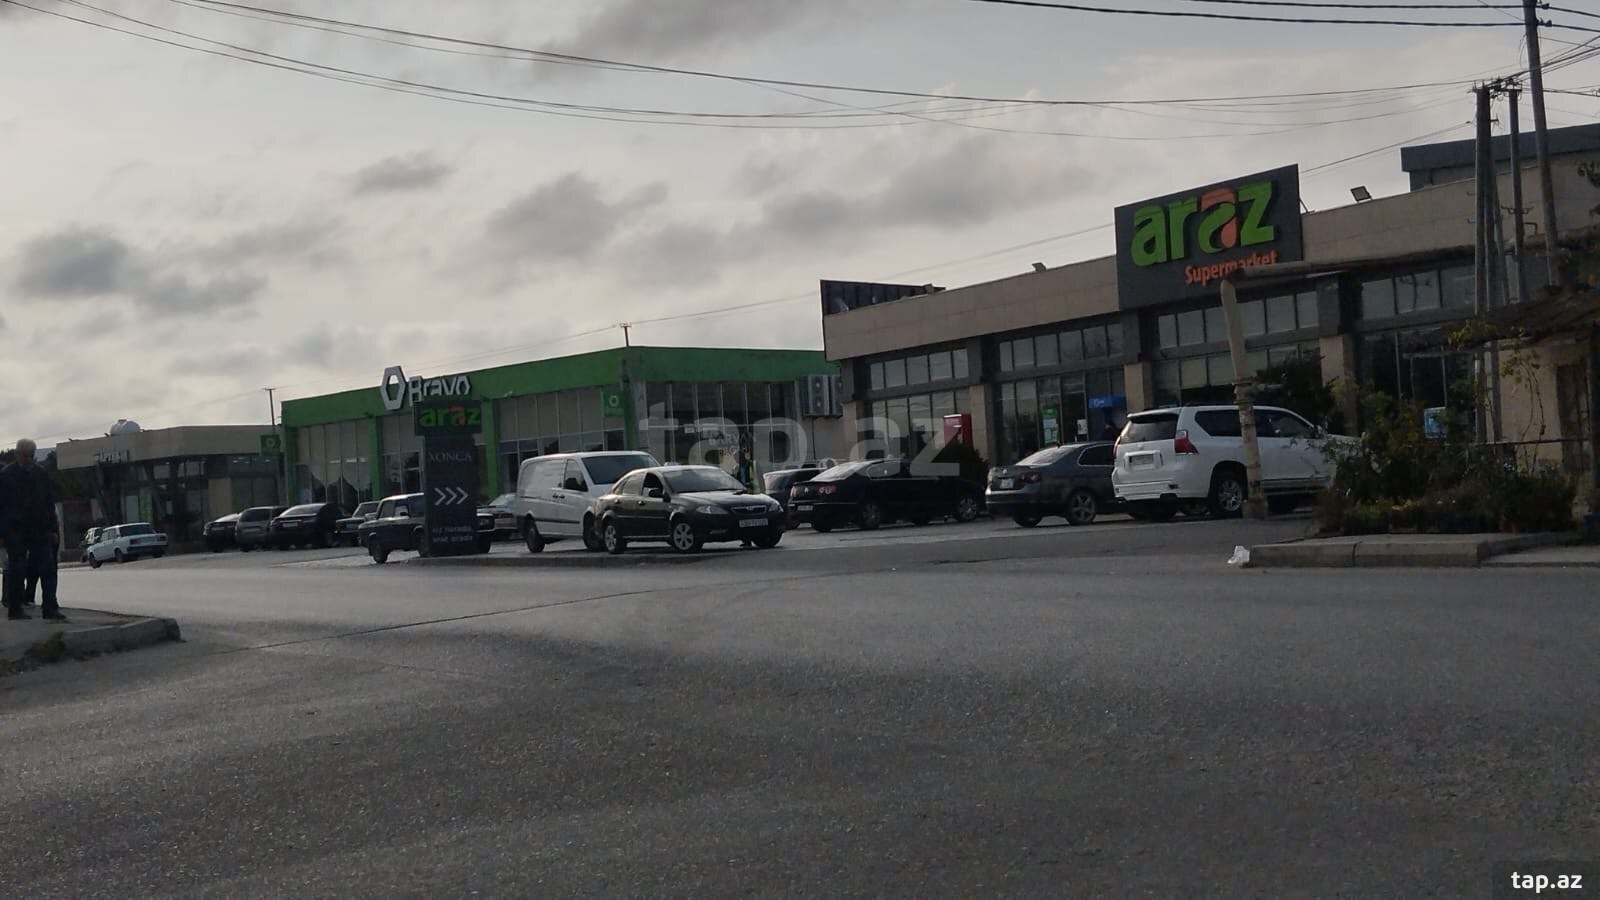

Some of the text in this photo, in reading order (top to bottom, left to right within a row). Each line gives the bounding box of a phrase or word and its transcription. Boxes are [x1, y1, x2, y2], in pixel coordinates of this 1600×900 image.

[1130, 181, 1275, 267] araz
[1185, 251, 1278, 287] Supermarket
[419, 406, 481, 426] araz
